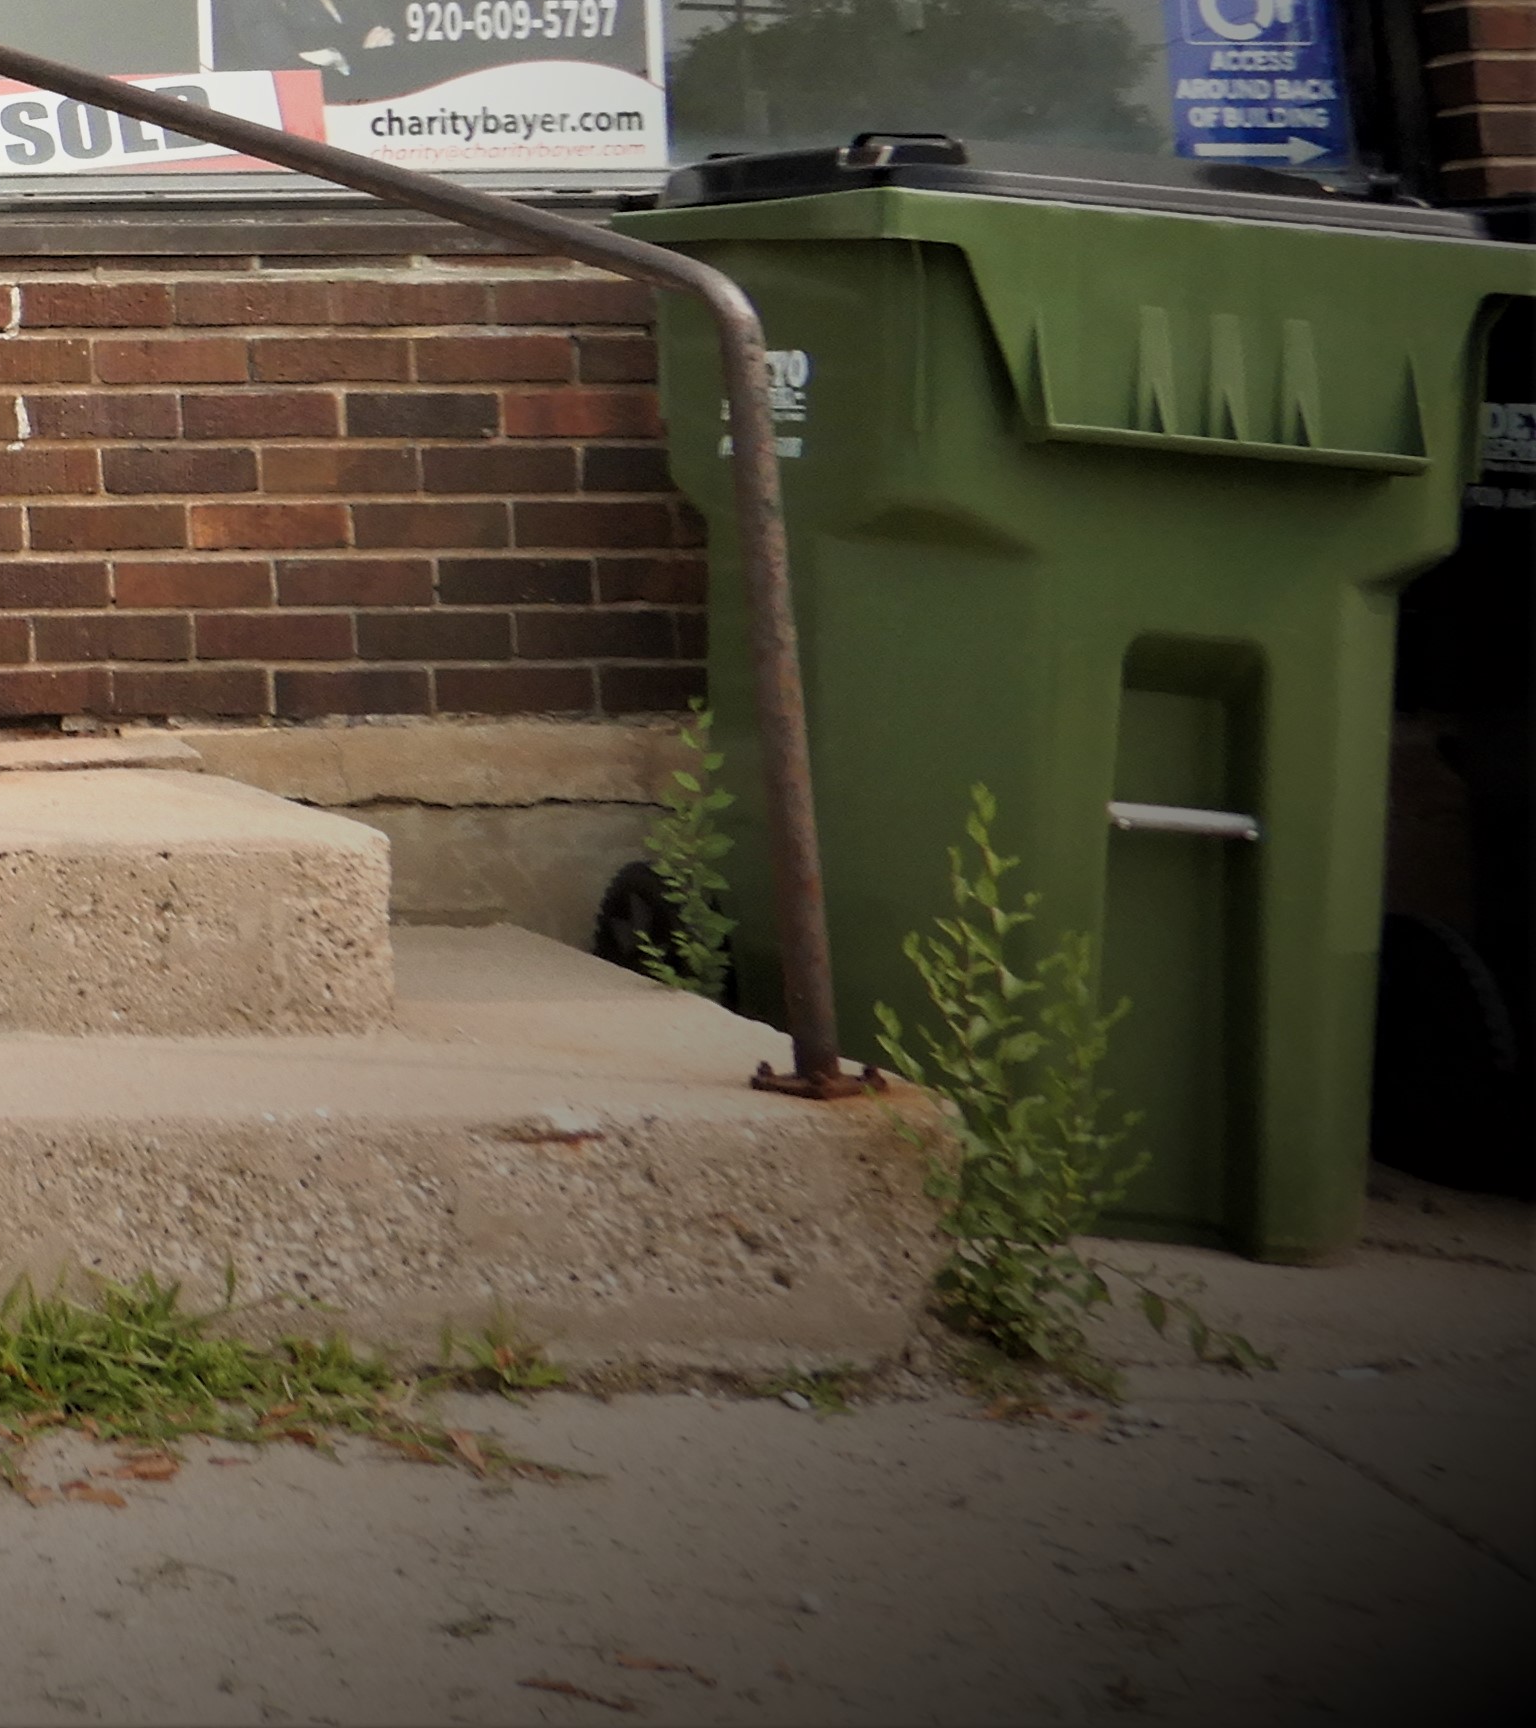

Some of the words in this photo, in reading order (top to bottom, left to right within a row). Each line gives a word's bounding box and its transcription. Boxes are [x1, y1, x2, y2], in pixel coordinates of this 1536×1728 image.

[1209, 50, 1297, 71] ACCESS
[1176, 78, 1272, 100] AROUND
[1274, 78, 1339, 100] BACK
[370, 106, 645, 142] charitybayer.com
[1188, 106, 1220, 128] OF
[1223, 106, 1330, 128] BUILDING
